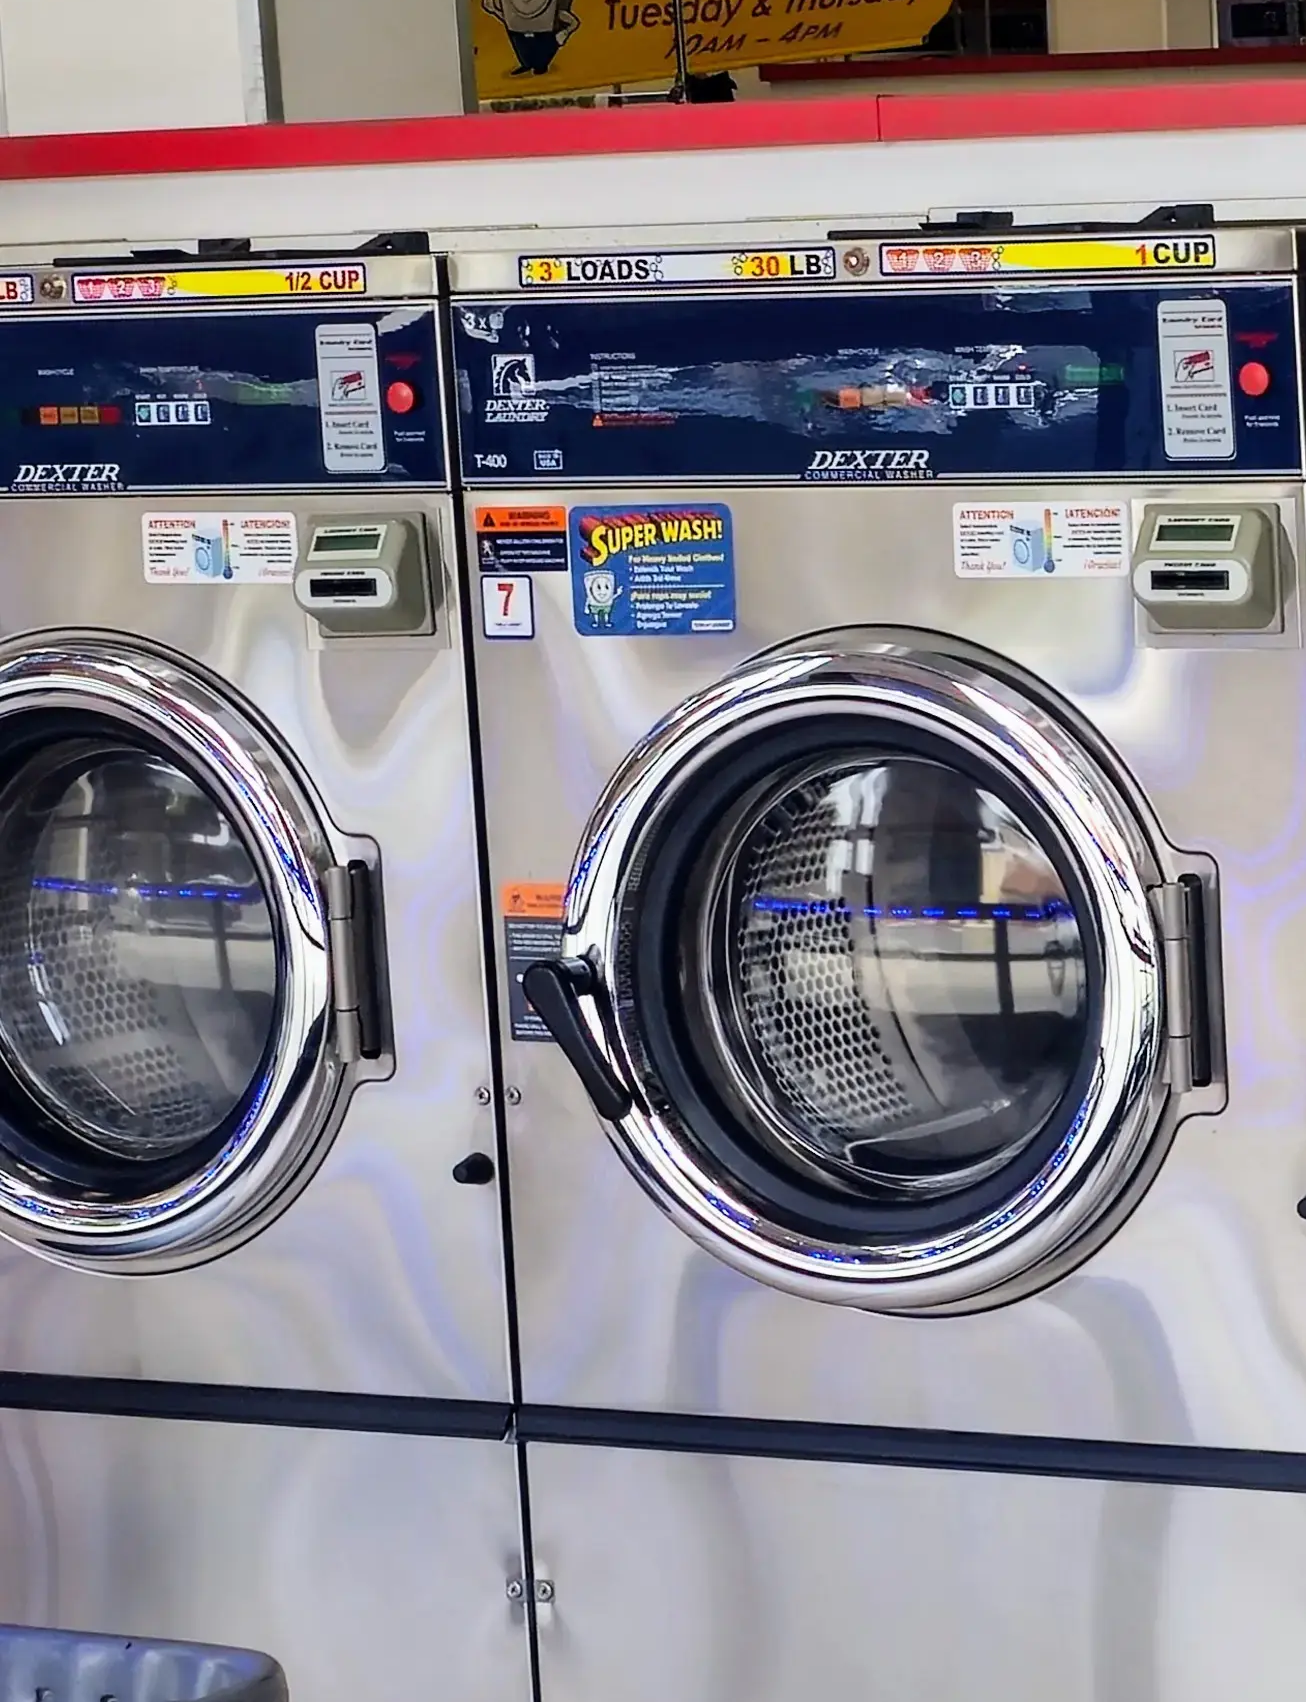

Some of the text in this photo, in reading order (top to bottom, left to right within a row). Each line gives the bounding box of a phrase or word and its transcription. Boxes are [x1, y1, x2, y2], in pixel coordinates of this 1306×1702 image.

[779, 21, 843, 44] 4PM
[1134, 242, 1210, 265] 1 CUP
[539, 253, 822, 281] 3 LOADS 30 LB
[285, 270, 360, 291] 1/2 CUP
[485, 399, 546, 412] DEXTER
[474, 453, 507, 470] T-400
[807, 450, 930, 470] DEXTER
[13, 463, 121, 482] DEXTER
[804, 469, 934, 480] COMMERCIAL WASHER
[10, 482, 125, 492] COMMERCIAL WASHER
[960, 510, 1014, 520] ATTENTION
[591, 523, 657, 566] SUPER
[661, 519, 723, 543] WASH!
[497, 583, 514, 616] 7
